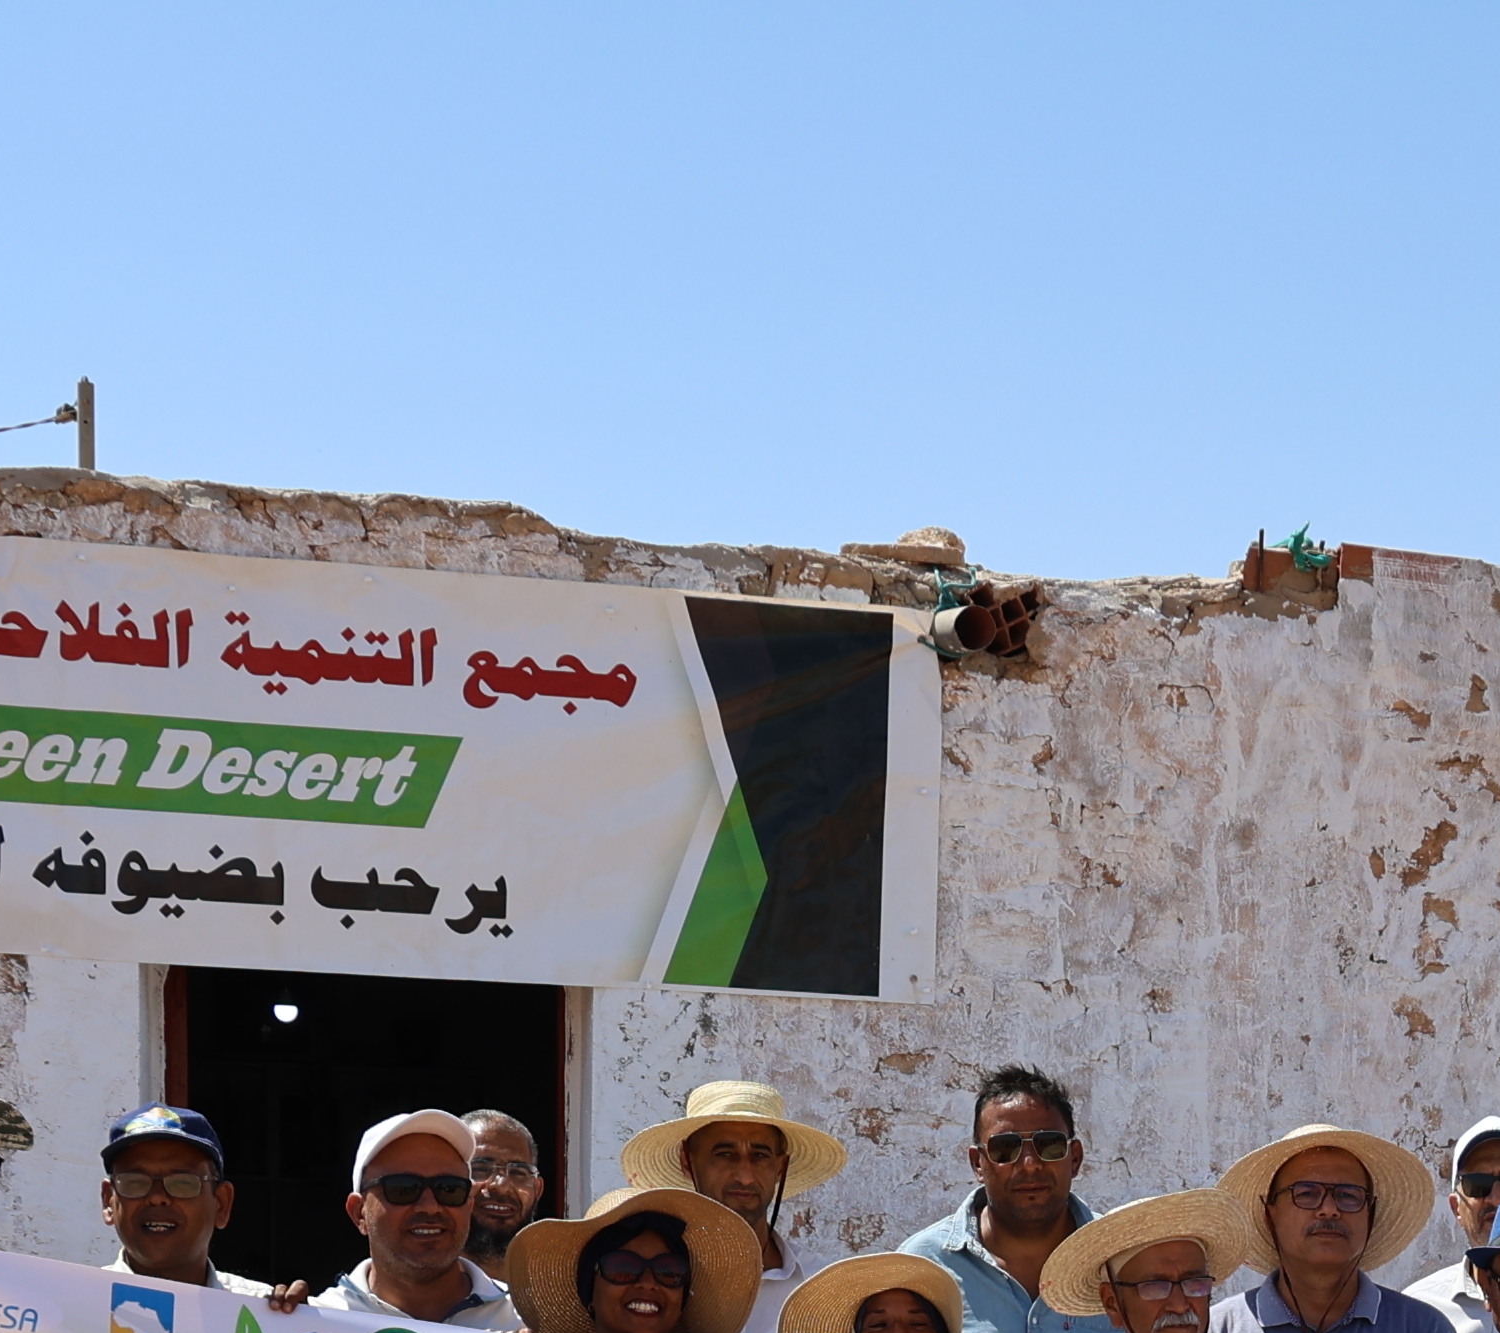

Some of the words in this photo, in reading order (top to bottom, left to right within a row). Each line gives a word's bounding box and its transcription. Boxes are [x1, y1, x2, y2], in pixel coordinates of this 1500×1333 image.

[220, 610, 437, 696] التنمية
[461, 646, 638, 715] مجمع
[137, 728, 417, 805] Desert
[32, 830, 286, 925] بضيوفه
[311, 863, 515, 939] يرحب
